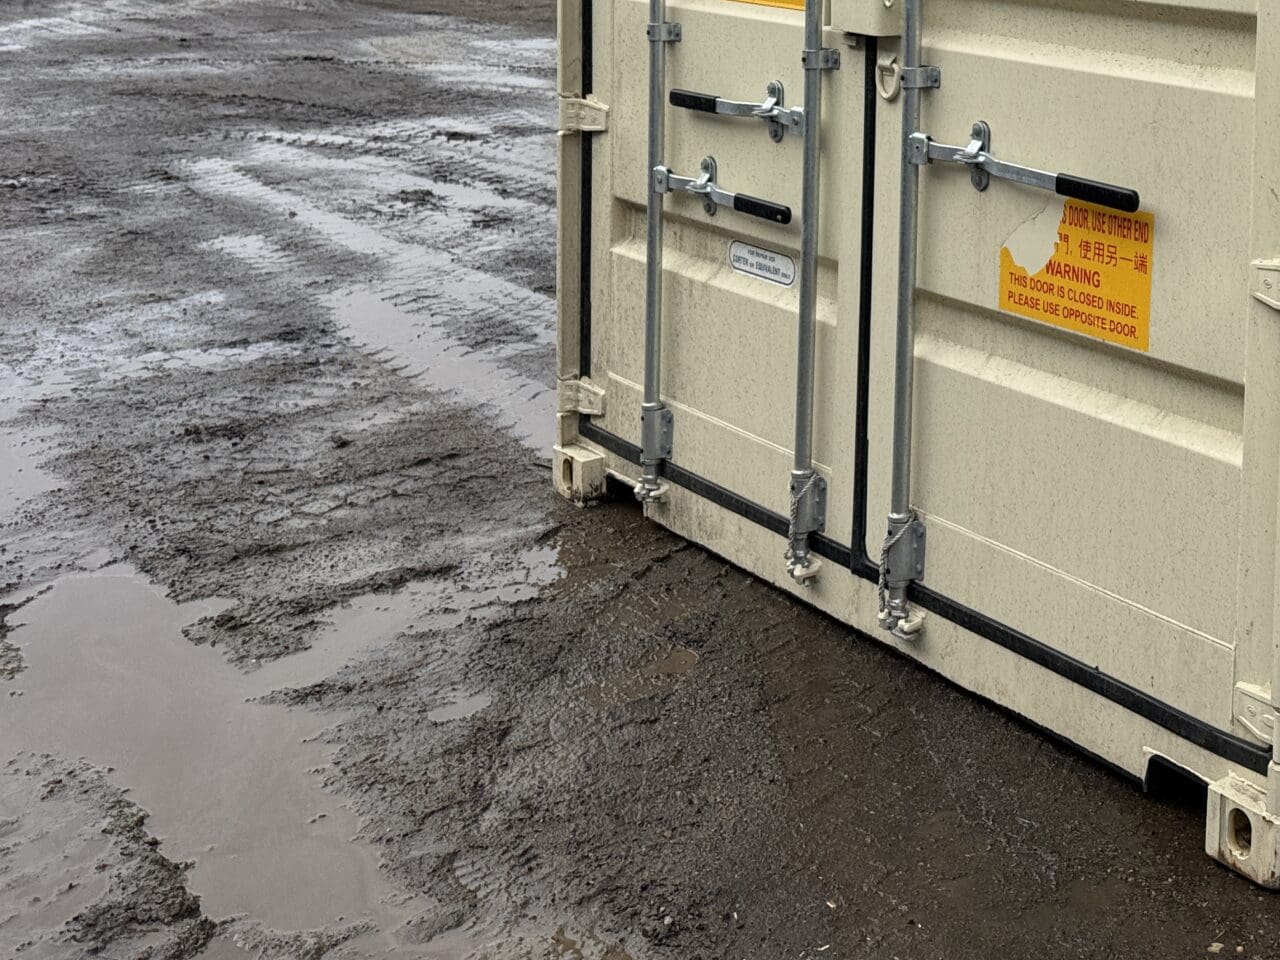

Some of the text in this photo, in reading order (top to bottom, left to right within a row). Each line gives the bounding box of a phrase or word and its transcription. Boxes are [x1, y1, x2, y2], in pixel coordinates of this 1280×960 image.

[1092, 209, 1106, 234] USE
[1108, 214, 1132, 240] OTHER
[1134, 220, 1149, 243] END
[1046, 260, 1101, 288] WARNING
[1008, 290, 1139, 340] PLEASE USE OPPOSITE DOOR.
[1009, 272, 1139, 319] THIS DOOR IS CLOSED INSIDE.
